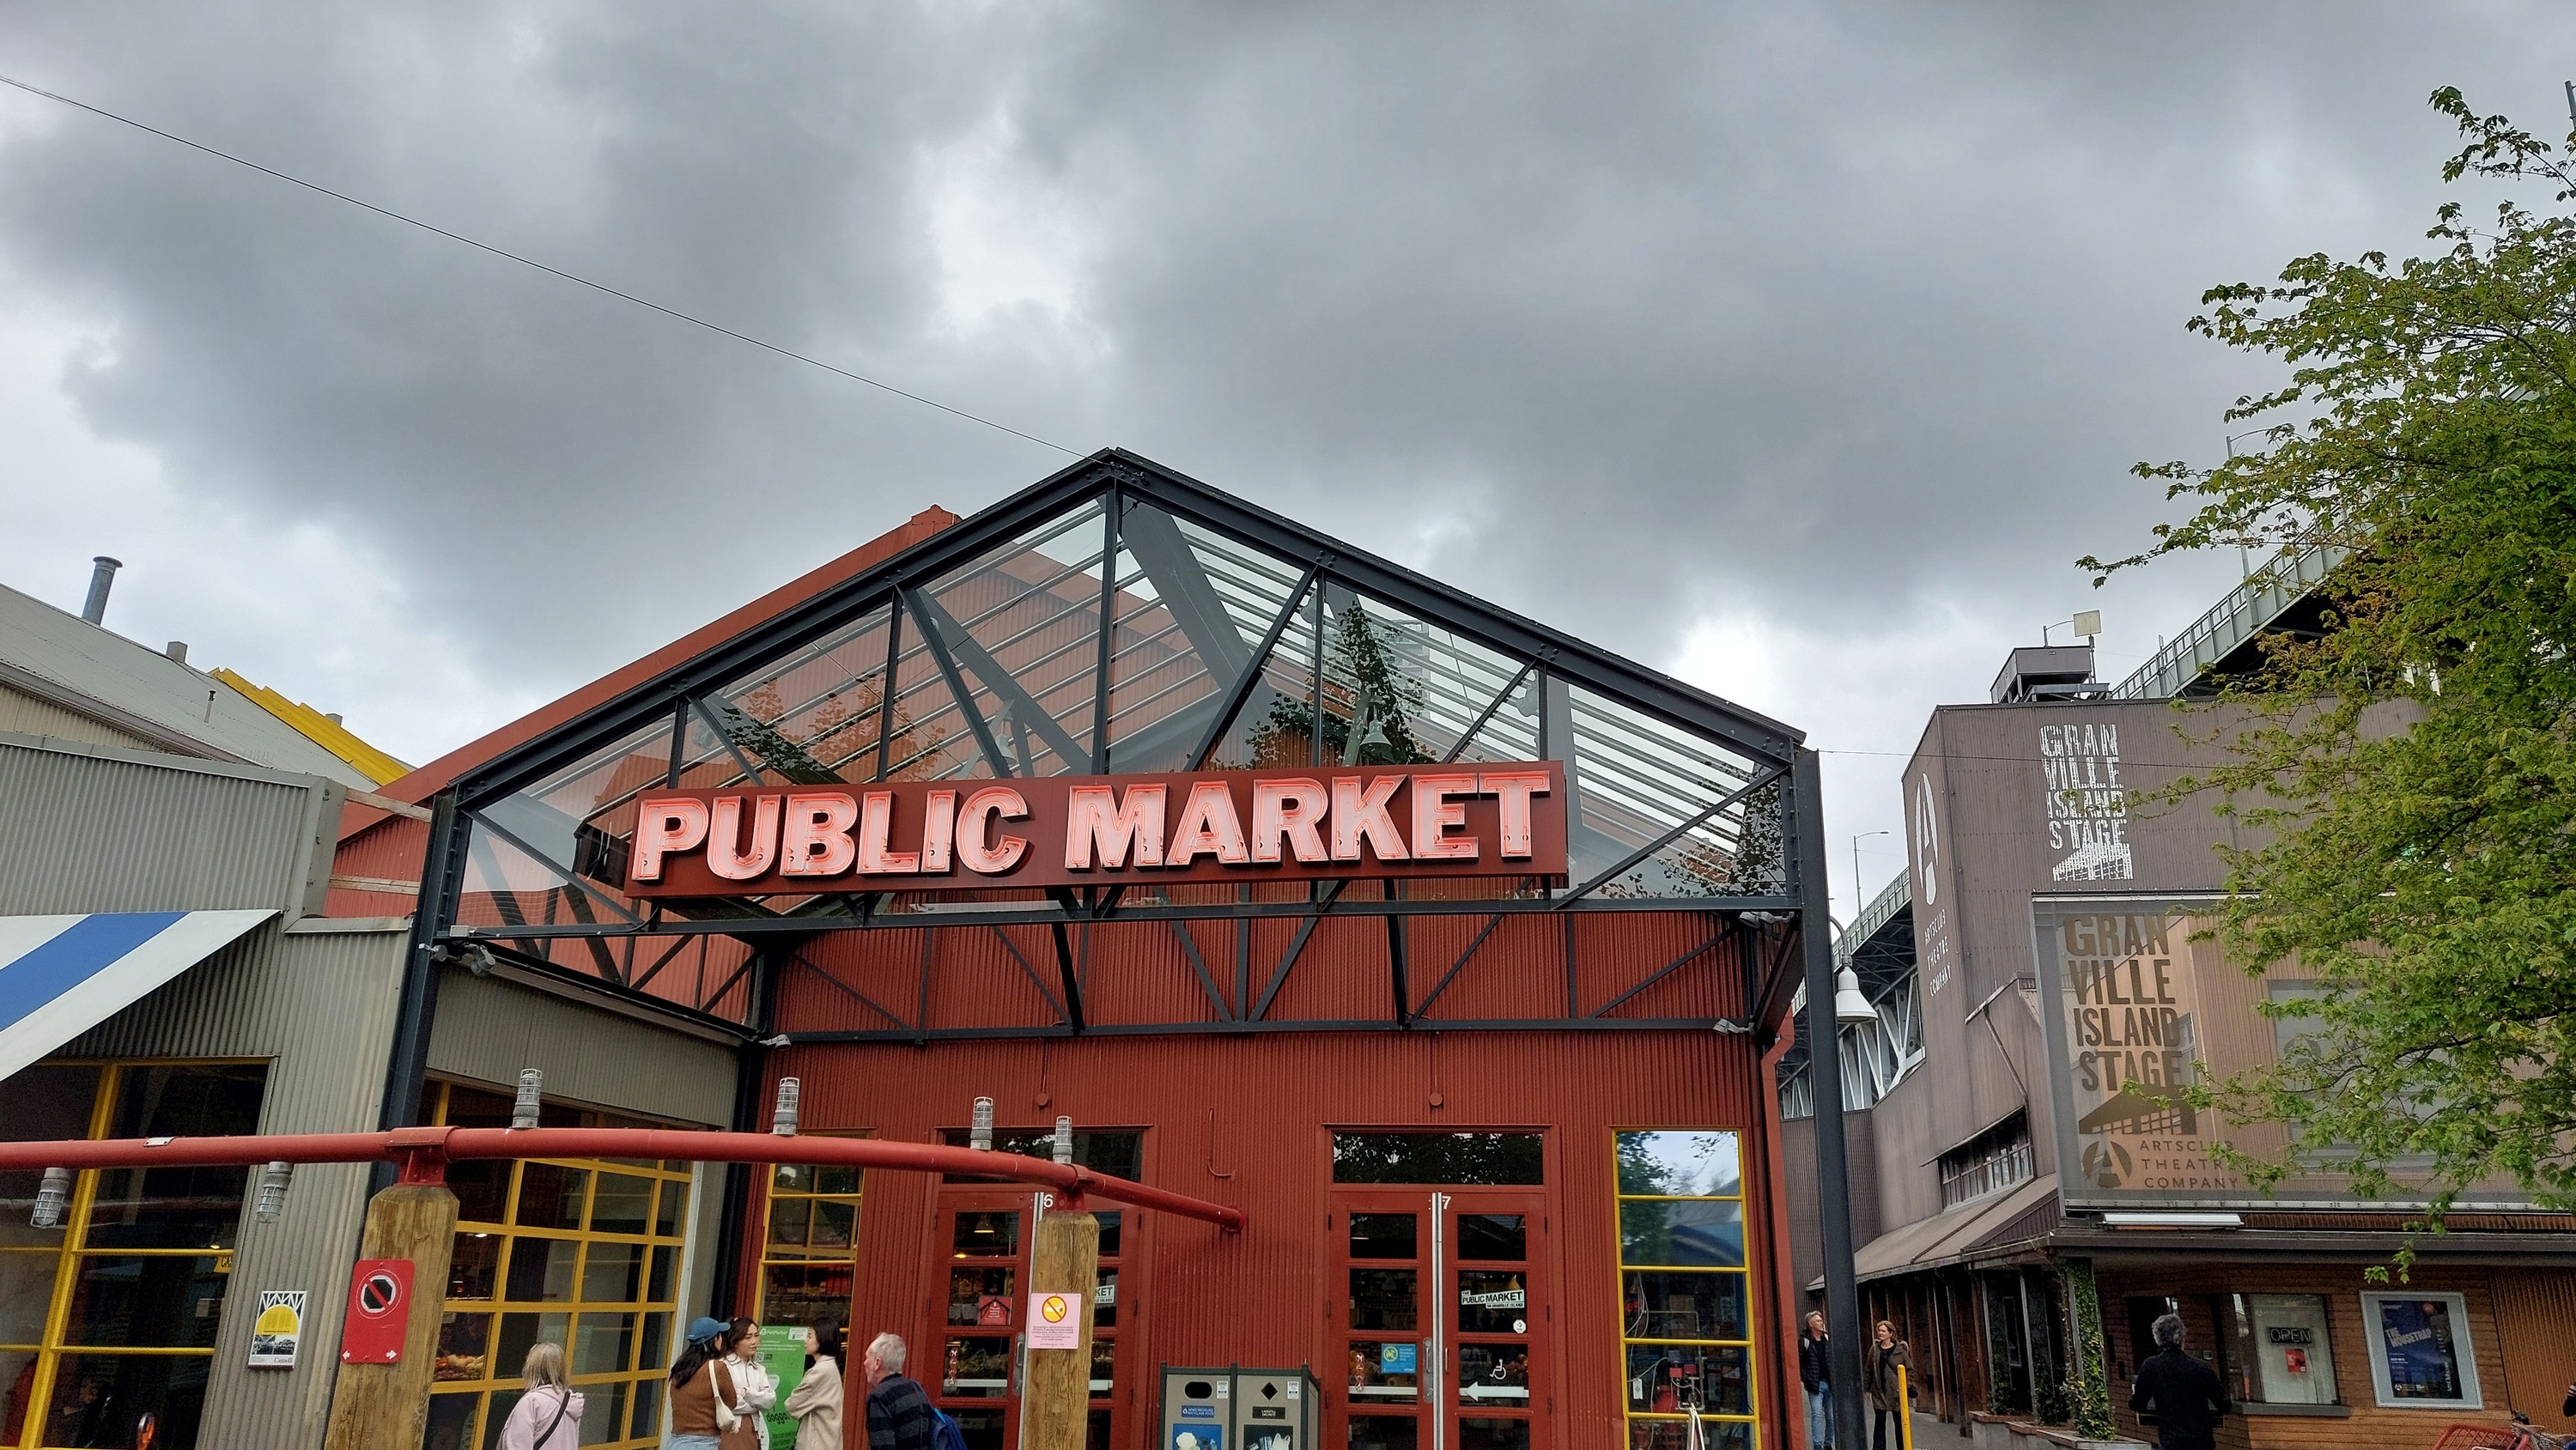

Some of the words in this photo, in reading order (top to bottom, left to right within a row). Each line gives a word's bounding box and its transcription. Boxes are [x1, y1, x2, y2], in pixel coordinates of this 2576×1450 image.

[2039, 724, 2118, 757] GRAN
[2042, 756, 2123, 790] VILLE
[2045, 790, 2126, 819] ISLAND
[631, 786, 1030, 882] PUBLIC
[1064, 770, 1551, 871] MARKET
[2049, 819, 2128, 850] STAGE
[1924, 908, 1946, 945] ARTSCLUB
[2063, 913, 2169, 956] GRAN
[1927, 936, 1948, 971] THEATRE
[1929, 962, 1951, 997] COMPANY
[2068, 959, 2176, 1004] VILLE
[2073, 1007, 2182, 1047] ISLAND
[2078, 1050, 2183, 1092] STAGE
[2142, 1158, 2235, 1170] THEATR
[2144, 1177, 2238, 1190] COMPANY
[1043, 1194, 1054, 1208] 6
[1442, 1195, 1451, 1210] 7
[1462, 1295, 1485, 1304] PUBLIC
[1485, 1291, 1523, 1302] MARKET
[2270, 1328, 2312, 1343] OPEN
[2385, 1326, 2400, 1339] THE
[2390, 1328, 2432, 1348] MOUSETRAP
